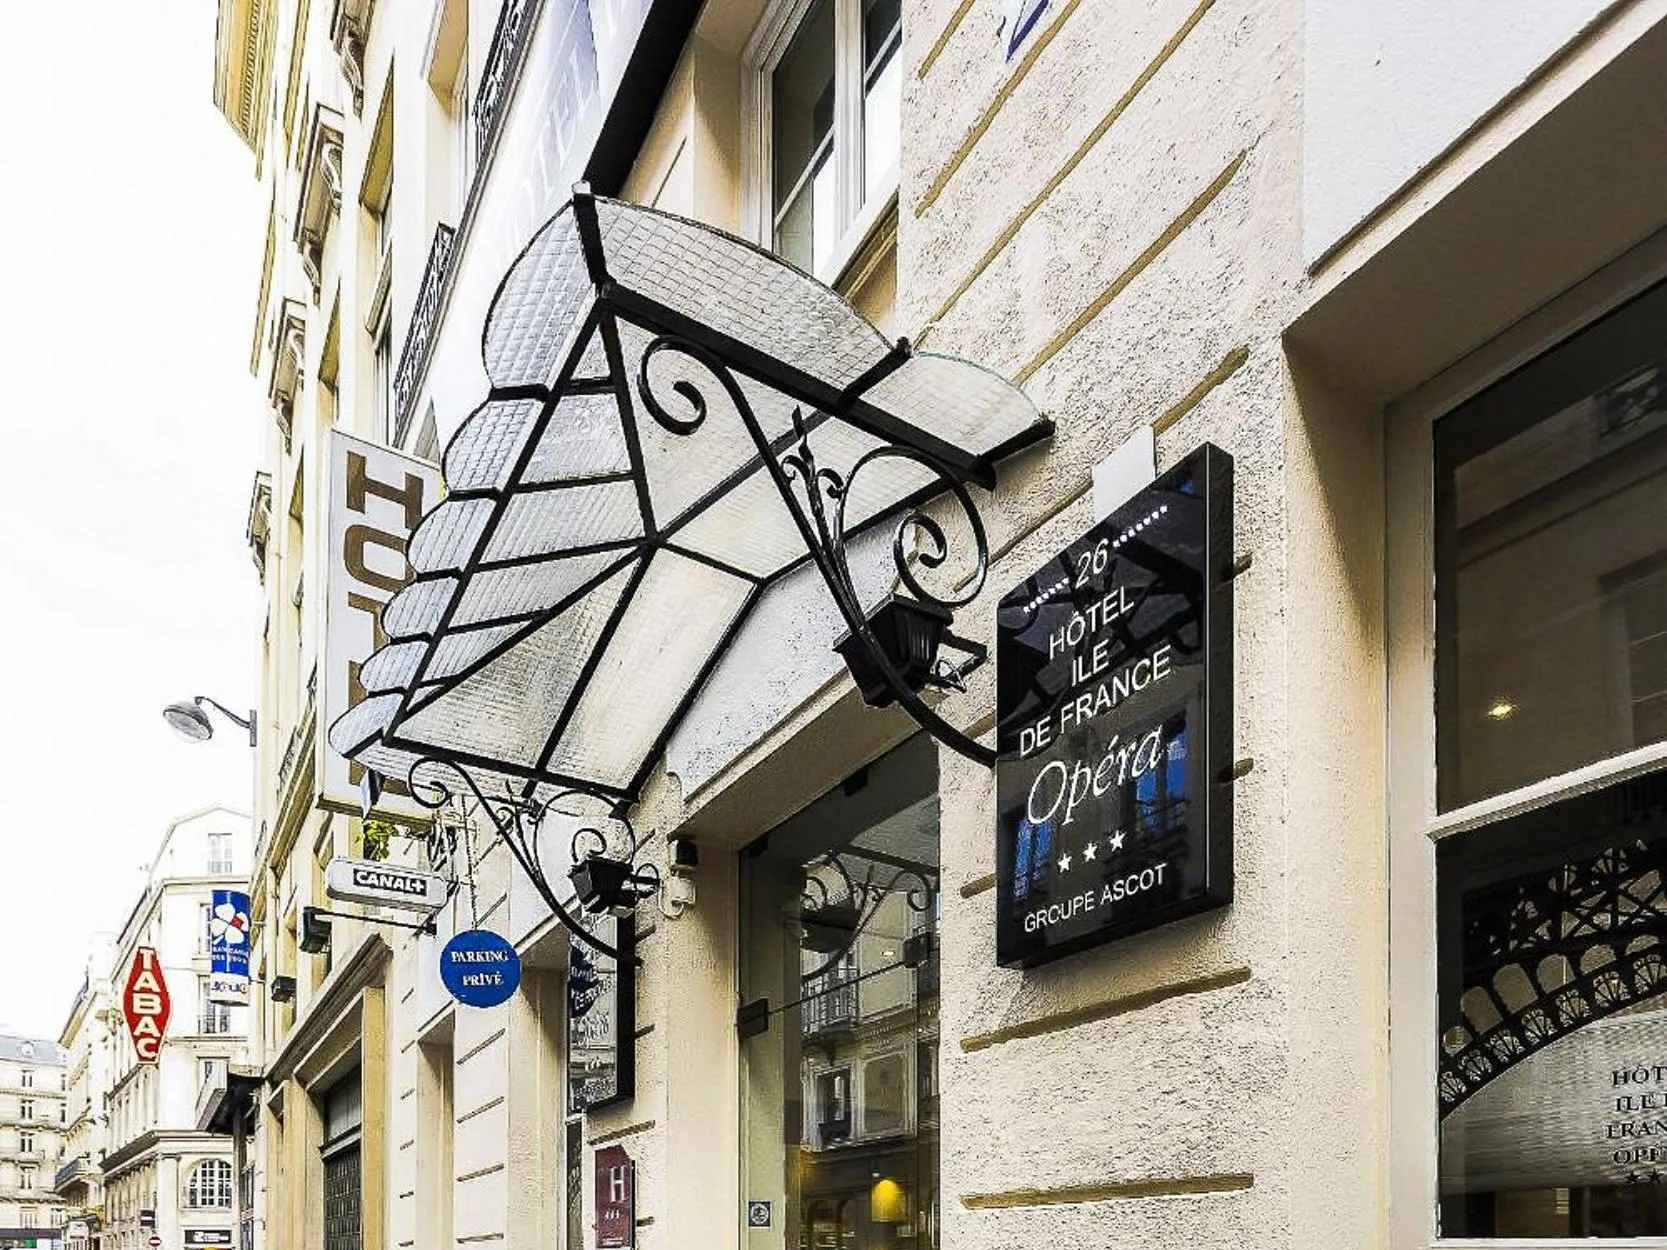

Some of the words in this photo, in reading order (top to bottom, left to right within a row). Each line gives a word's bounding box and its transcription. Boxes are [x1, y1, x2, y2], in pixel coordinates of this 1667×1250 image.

[1074, 538, 1110, 589] 26
[1048, 585, 1135, 661] HÔTEL
[1071, 642, 1110, 687] ILE
[1019, 716, 1053, 759] DE
[1060, 644, 1172, 735] FRANCE
[1027, 723, 1164, 826] Opéra
[355, 871, 425, 893] CANAL+
[1024, 890, 1095, 934] GROUPE
[1100, 862, 1168, 906] ASCOT
[451, 950, 509, 963] PARKING
[462, 971, 505, 986] PRIVÉ
[133, 948, 162, 1060] TABAC
